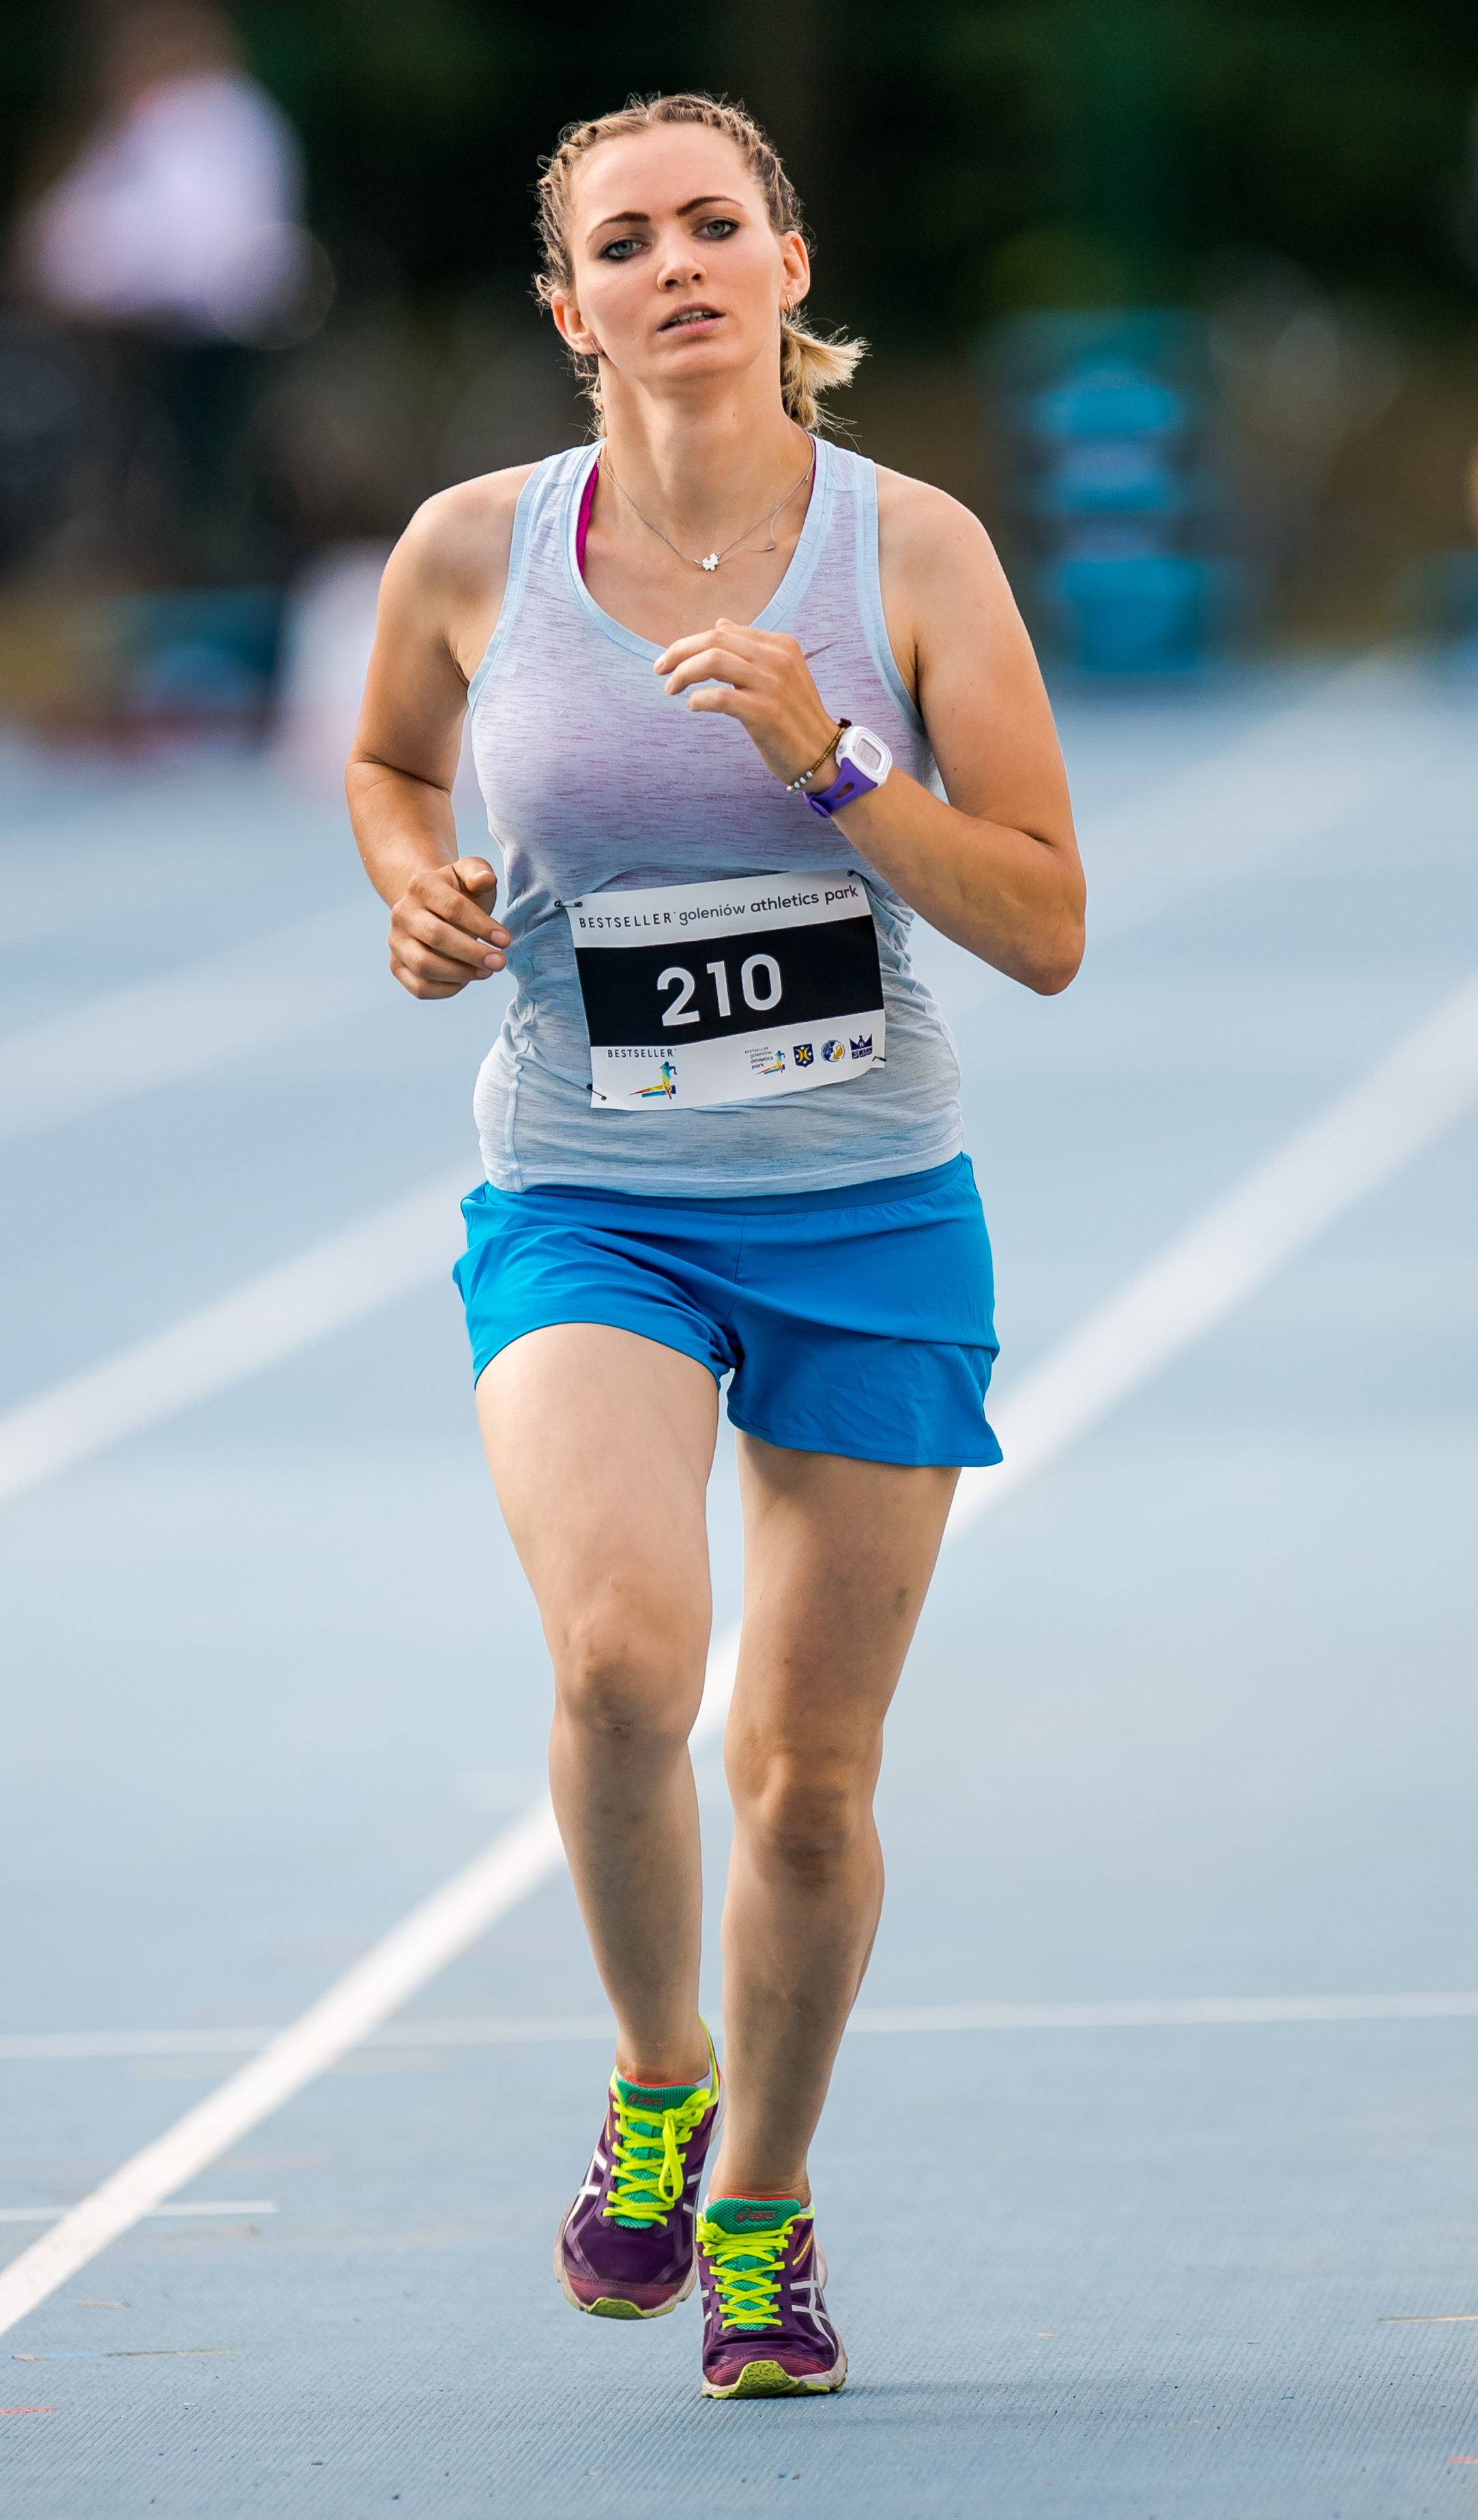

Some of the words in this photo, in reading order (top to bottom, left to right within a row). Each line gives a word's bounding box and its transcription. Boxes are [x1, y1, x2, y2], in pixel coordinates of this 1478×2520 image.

[579, 912, 672, 928] BESTSELLER
[679, 904, 746, 925] goleniów
[750, 892, 820, 913] athletics
[824, 885, 859, 905] park
[656, 954, 783, 1027] 210
[607, 1049, 673, 1058] BESTSELLER
